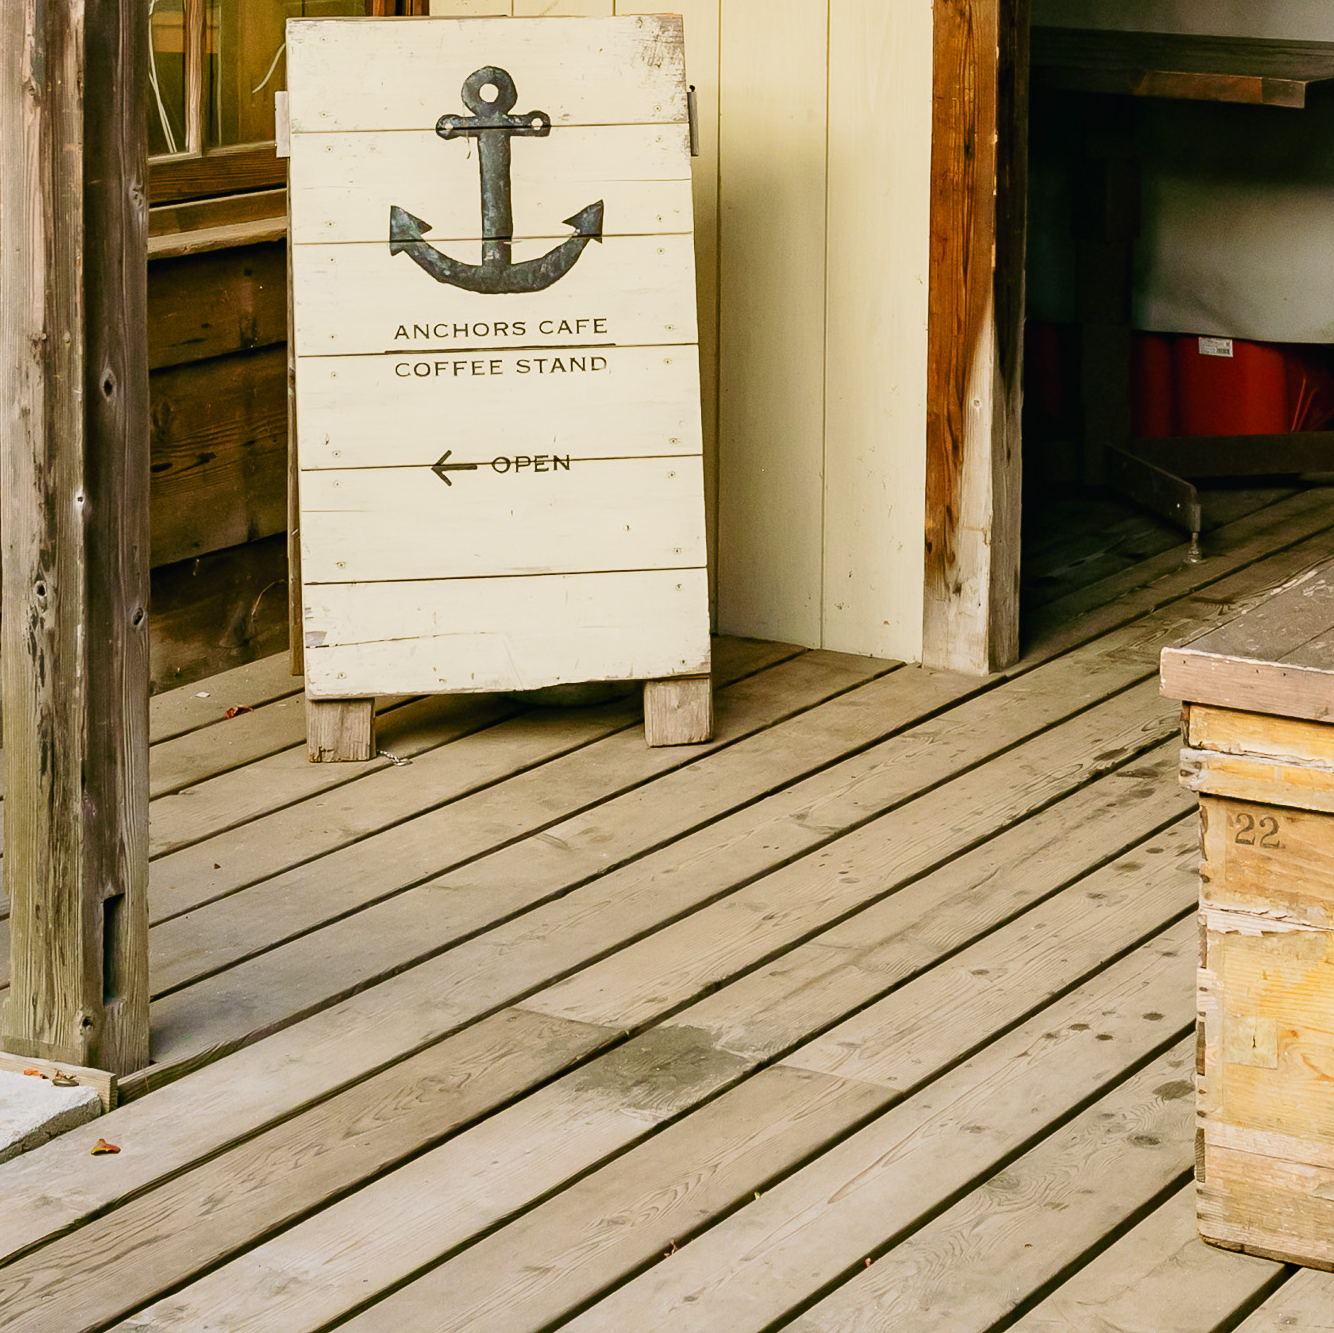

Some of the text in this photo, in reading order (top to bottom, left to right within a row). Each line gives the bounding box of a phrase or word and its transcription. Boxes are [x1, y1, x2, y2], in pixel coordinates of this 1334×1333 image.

[393, 317, 609, 340] ANCHORS CAFE
[394, 356, 608, 378] COFFEE STAND
[491, 453, 572, 474] OPEN
[1234, 812, 1282, 849] 22
